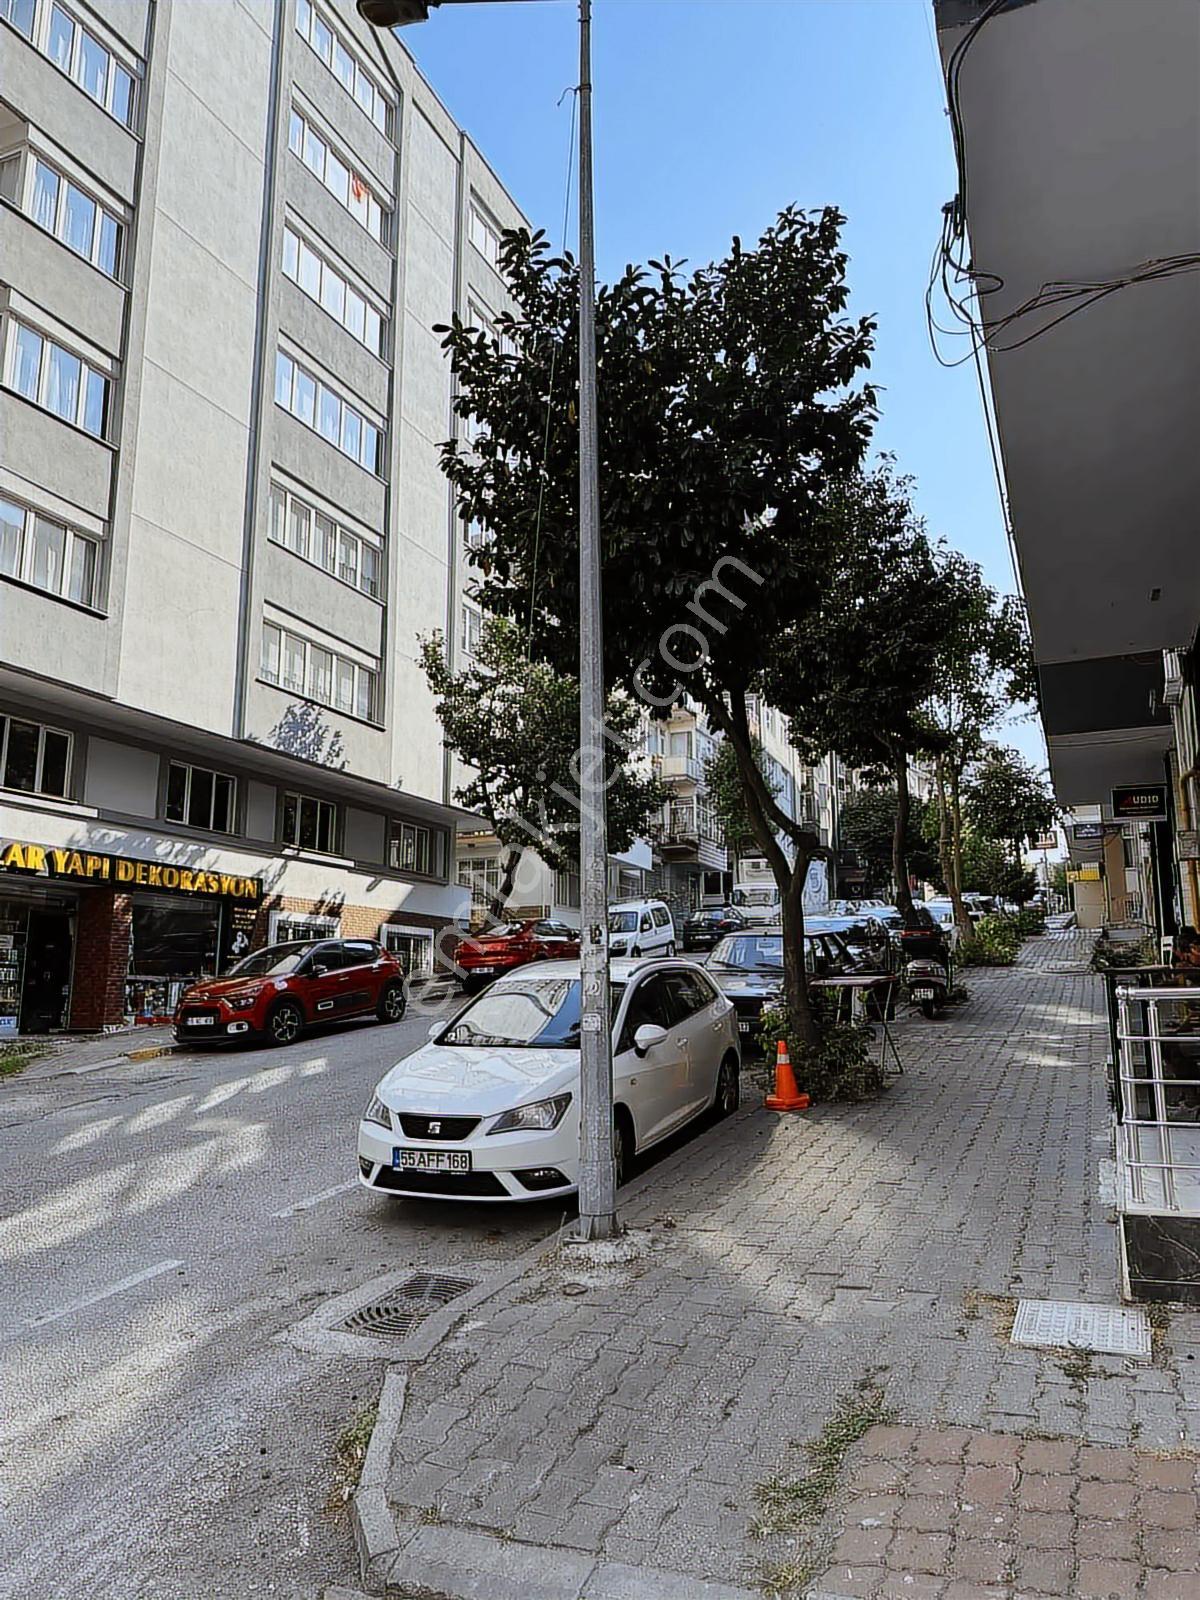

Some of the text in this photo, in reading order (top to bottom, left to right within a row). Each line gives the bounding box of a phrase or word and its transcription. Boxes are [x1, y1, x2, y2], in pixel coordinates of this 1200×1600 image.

[0, 842, 258, 899] AR YAPI DEKORASYON
